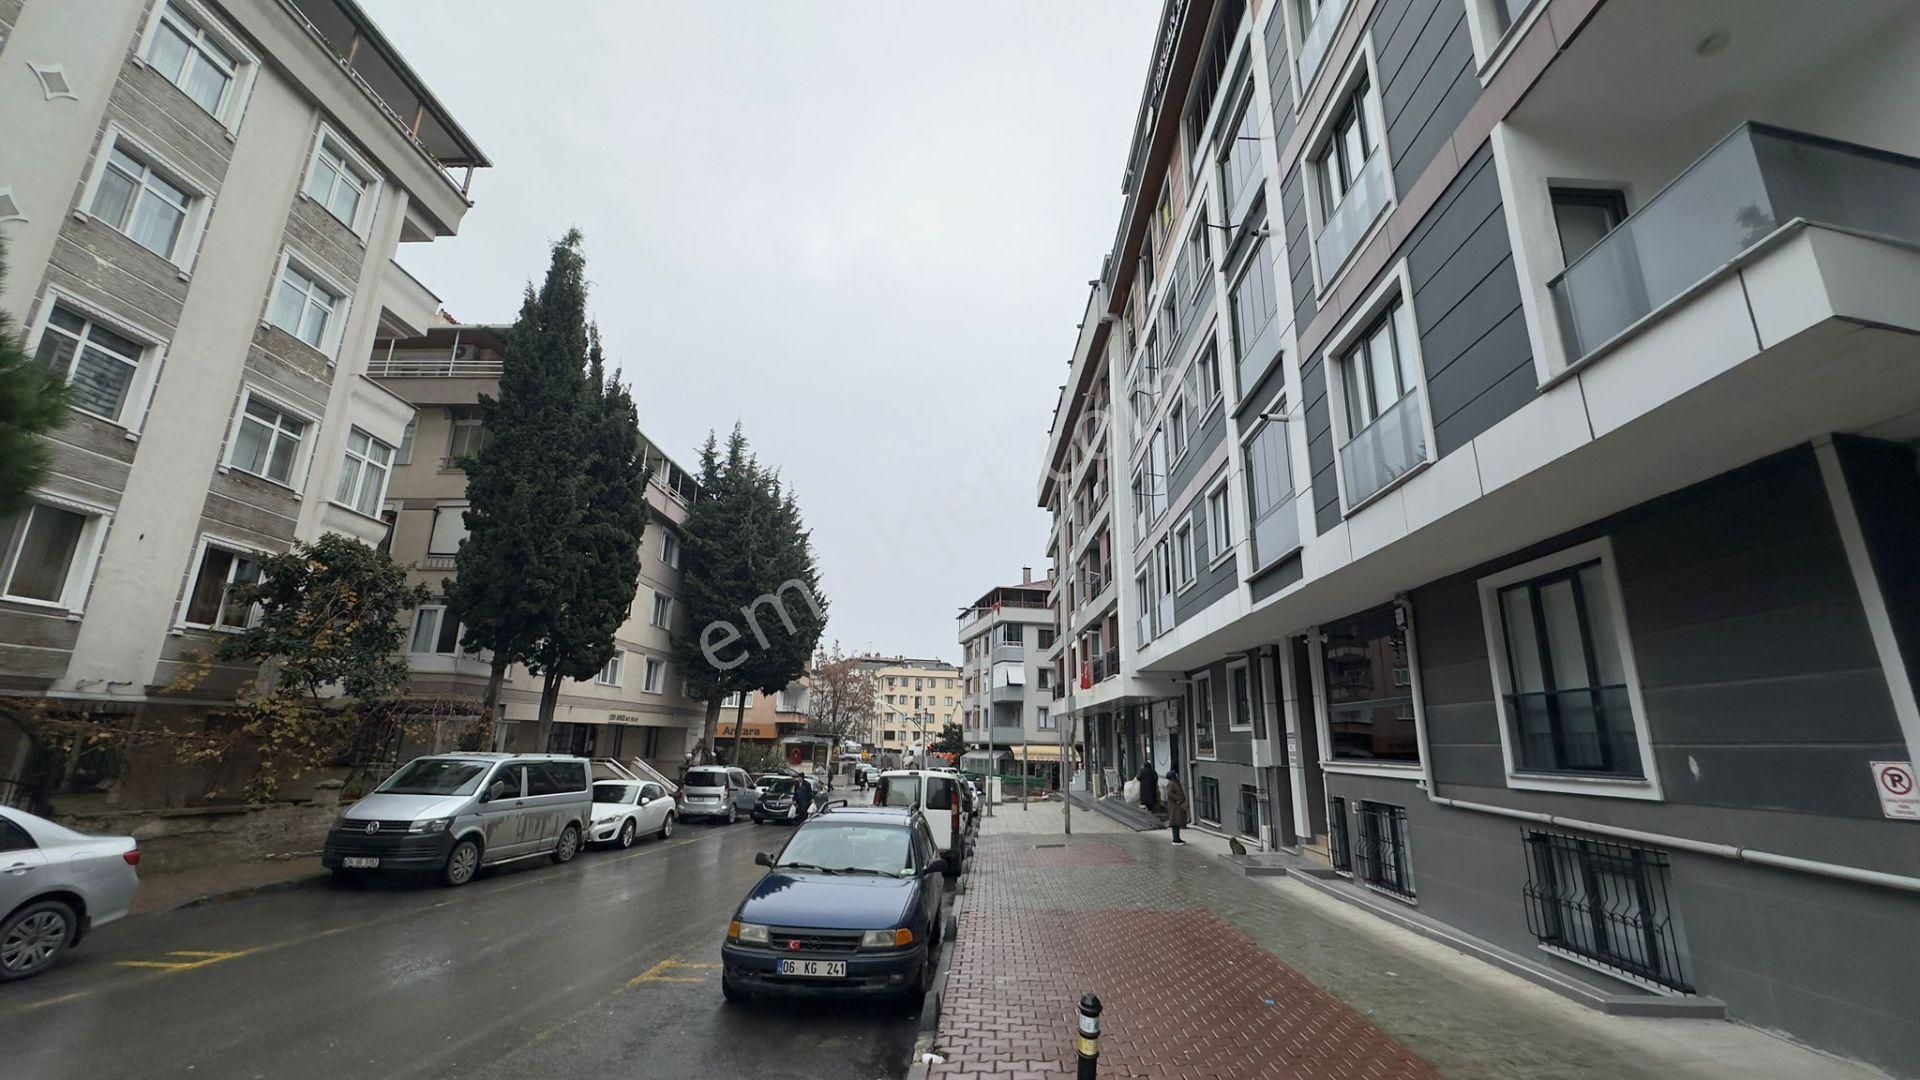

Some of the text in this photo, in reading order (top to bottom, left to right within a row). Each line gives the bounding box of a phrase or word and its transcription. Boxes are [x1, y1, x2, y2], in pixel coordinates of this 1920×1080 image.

[722, 726, 761, 736] Anara
[783, 961, 795, 973] 06
[804, 962, 817, 974] KG
[827, 963, 845, 975] 241
